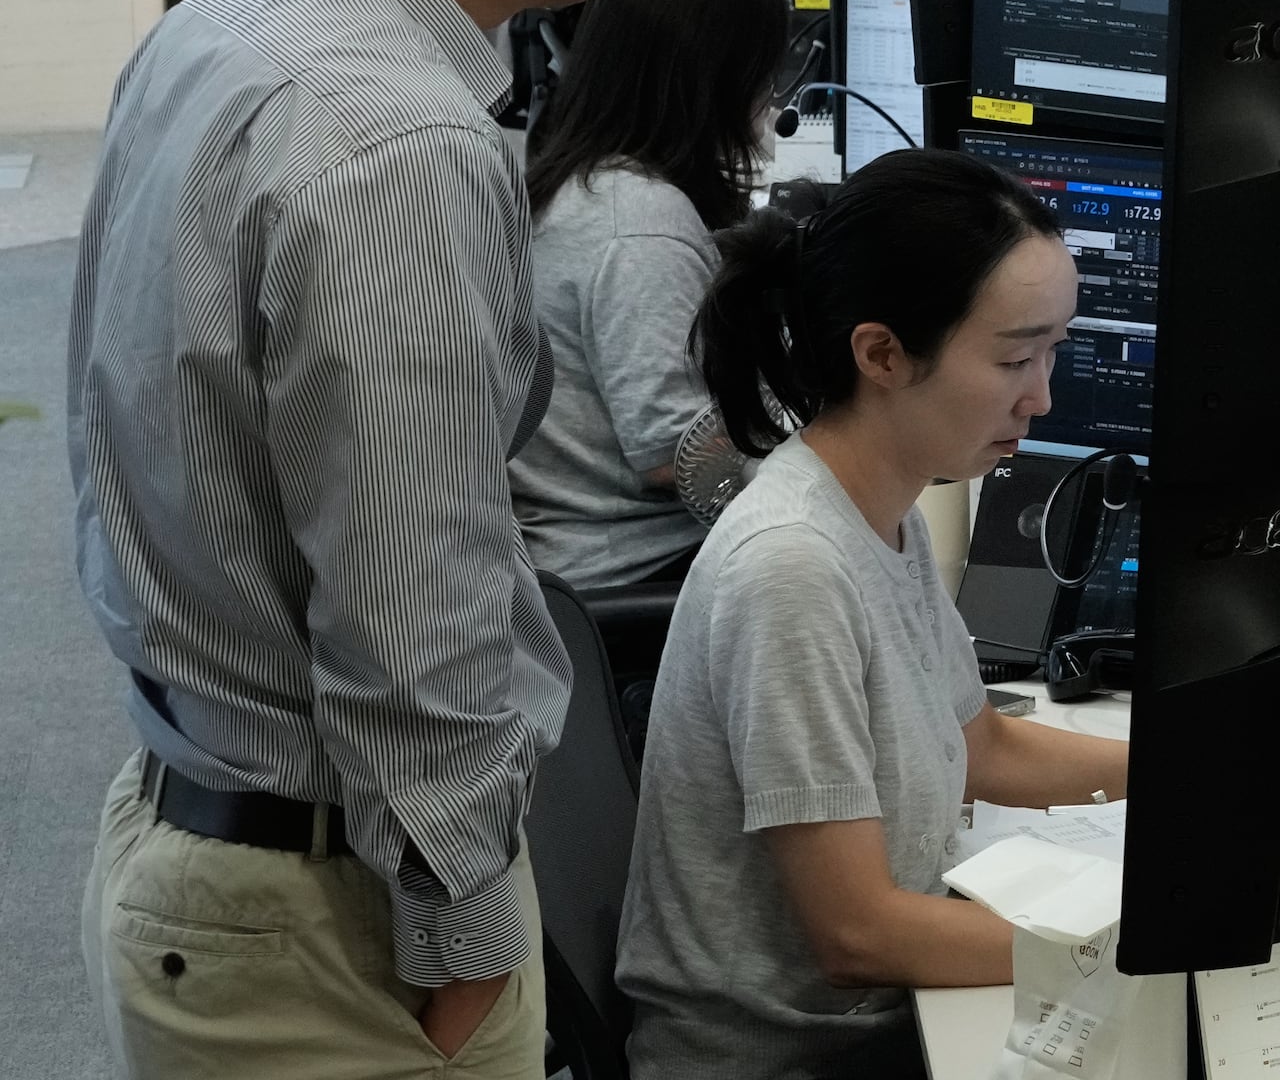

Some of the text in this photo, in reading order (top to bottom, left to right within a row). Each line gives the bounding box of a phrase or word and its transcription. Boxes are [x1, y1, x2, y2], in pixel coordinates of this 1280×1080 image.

[1072, 200, 1110, 216] 1372.9
[1124, 206, 1161, 221] 1372.9
[994, 468, 1012, 478] IPC
[1213, 1014, 1220, 1022] 13
[1262, 1048, 1269, 1056] 21
[1218, 1058, 1226, 1066] 20
